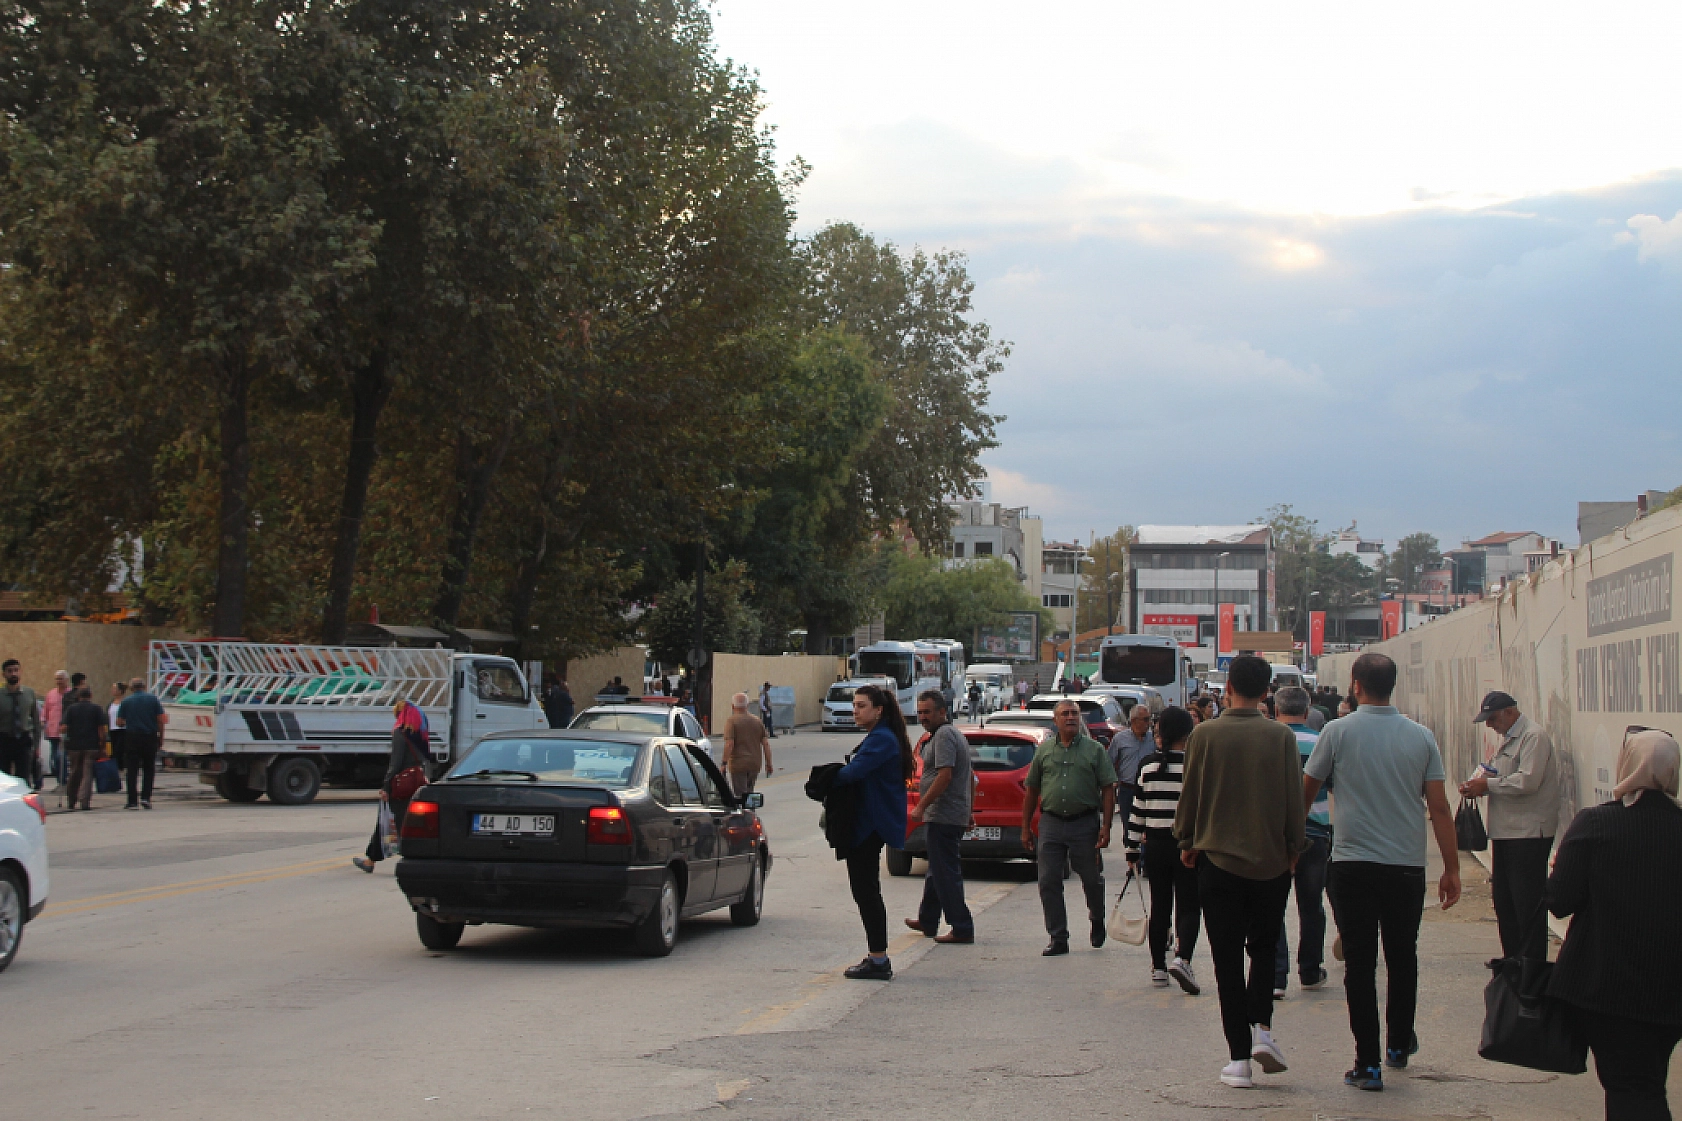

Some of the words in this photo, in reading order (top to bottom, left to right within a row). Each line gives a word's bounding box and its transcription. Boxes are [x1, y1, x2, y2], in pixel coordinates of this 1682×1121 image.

[480, 816, 495, 830] 44
[505, 816, 520, 831] AD
[532, 816, 553, 831] 150
